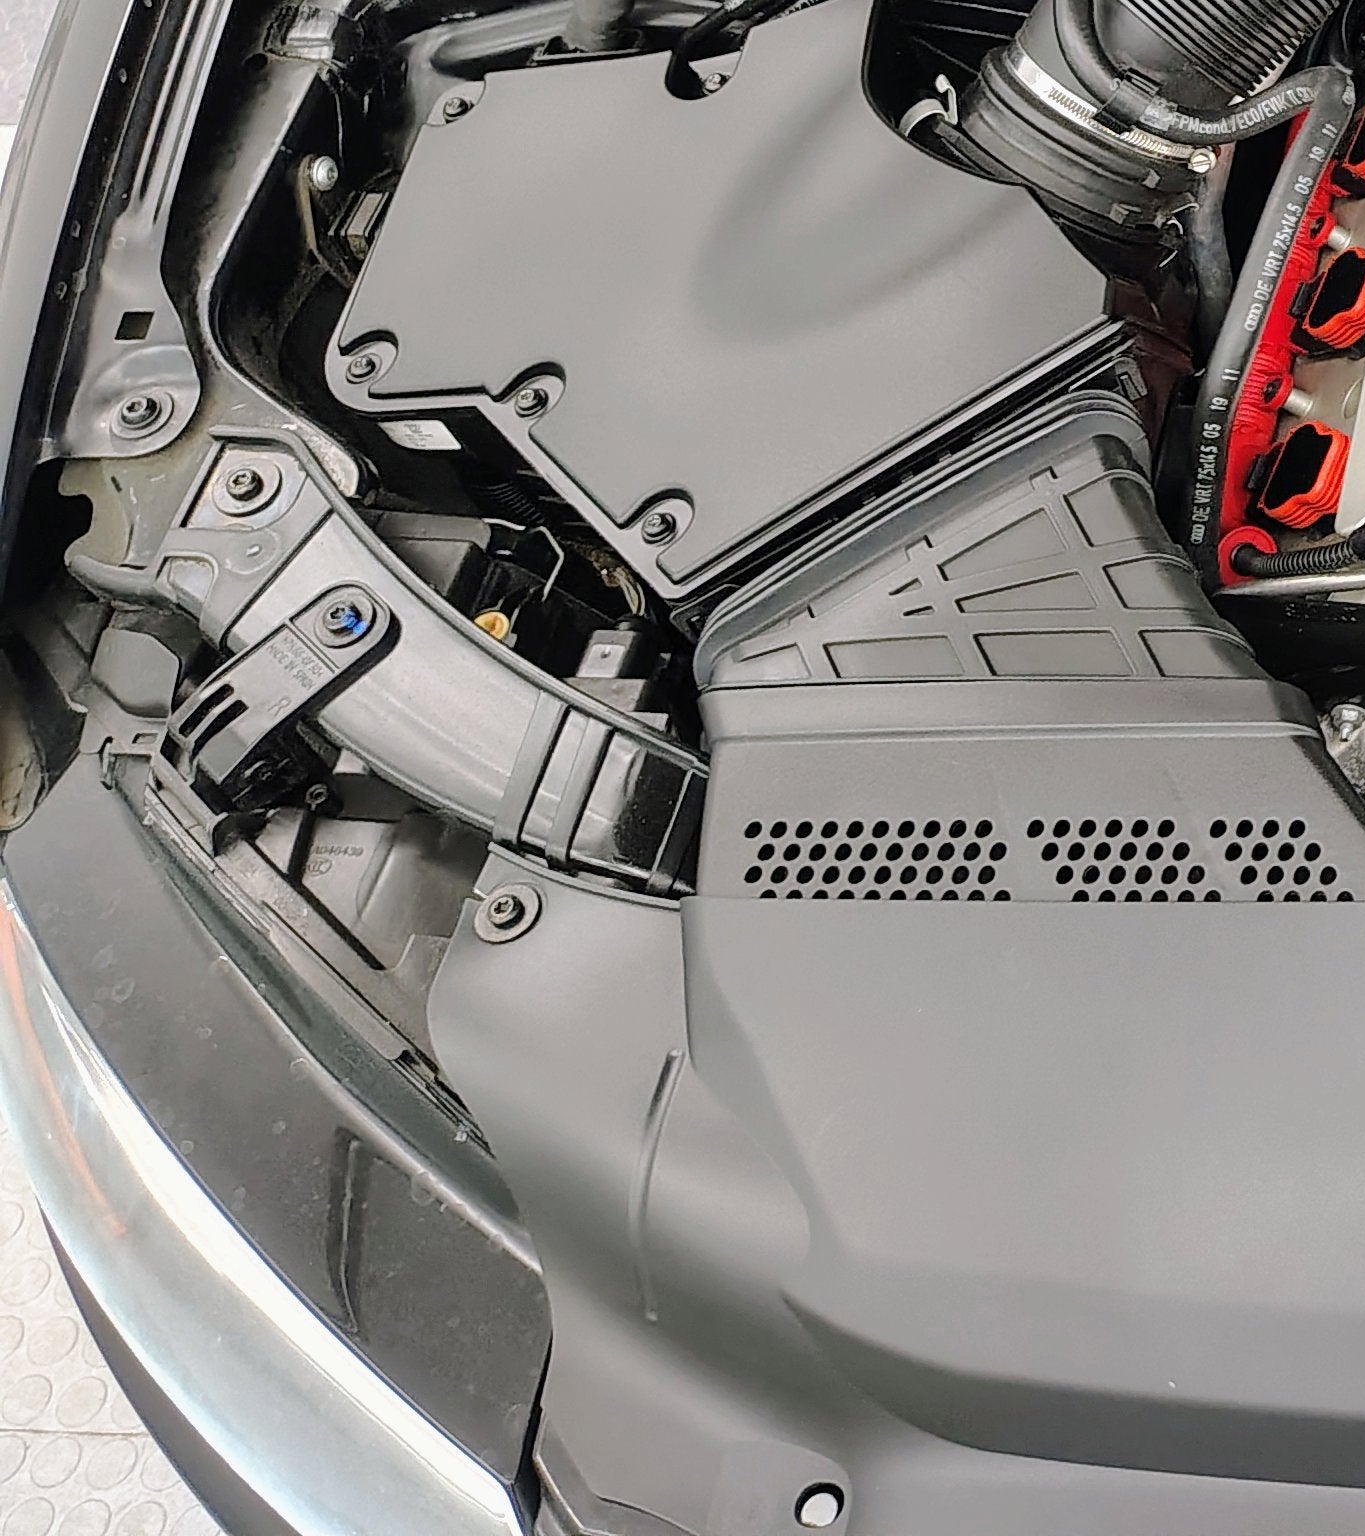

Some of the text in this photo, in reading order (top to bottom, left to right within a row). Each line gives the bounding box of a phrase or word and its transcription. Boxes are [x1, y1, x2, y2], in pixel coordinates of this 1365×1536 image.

[1322, 122, 1338, 139] 11
[1309, 145, 1326, 163] 19
[1294, 174, 1314, 195] 05
[1262, 251, 1285, 278] VRT
[1254, 279, 1273, 301] DE
[1221, 368, 1240, 381] 11
[1209, 396, 1229, 412] 19
[1202, 422, 1222, 439] 05
[1194, 483, 1212, 505] VRT
[1192, 506, 1211, 522] DE
